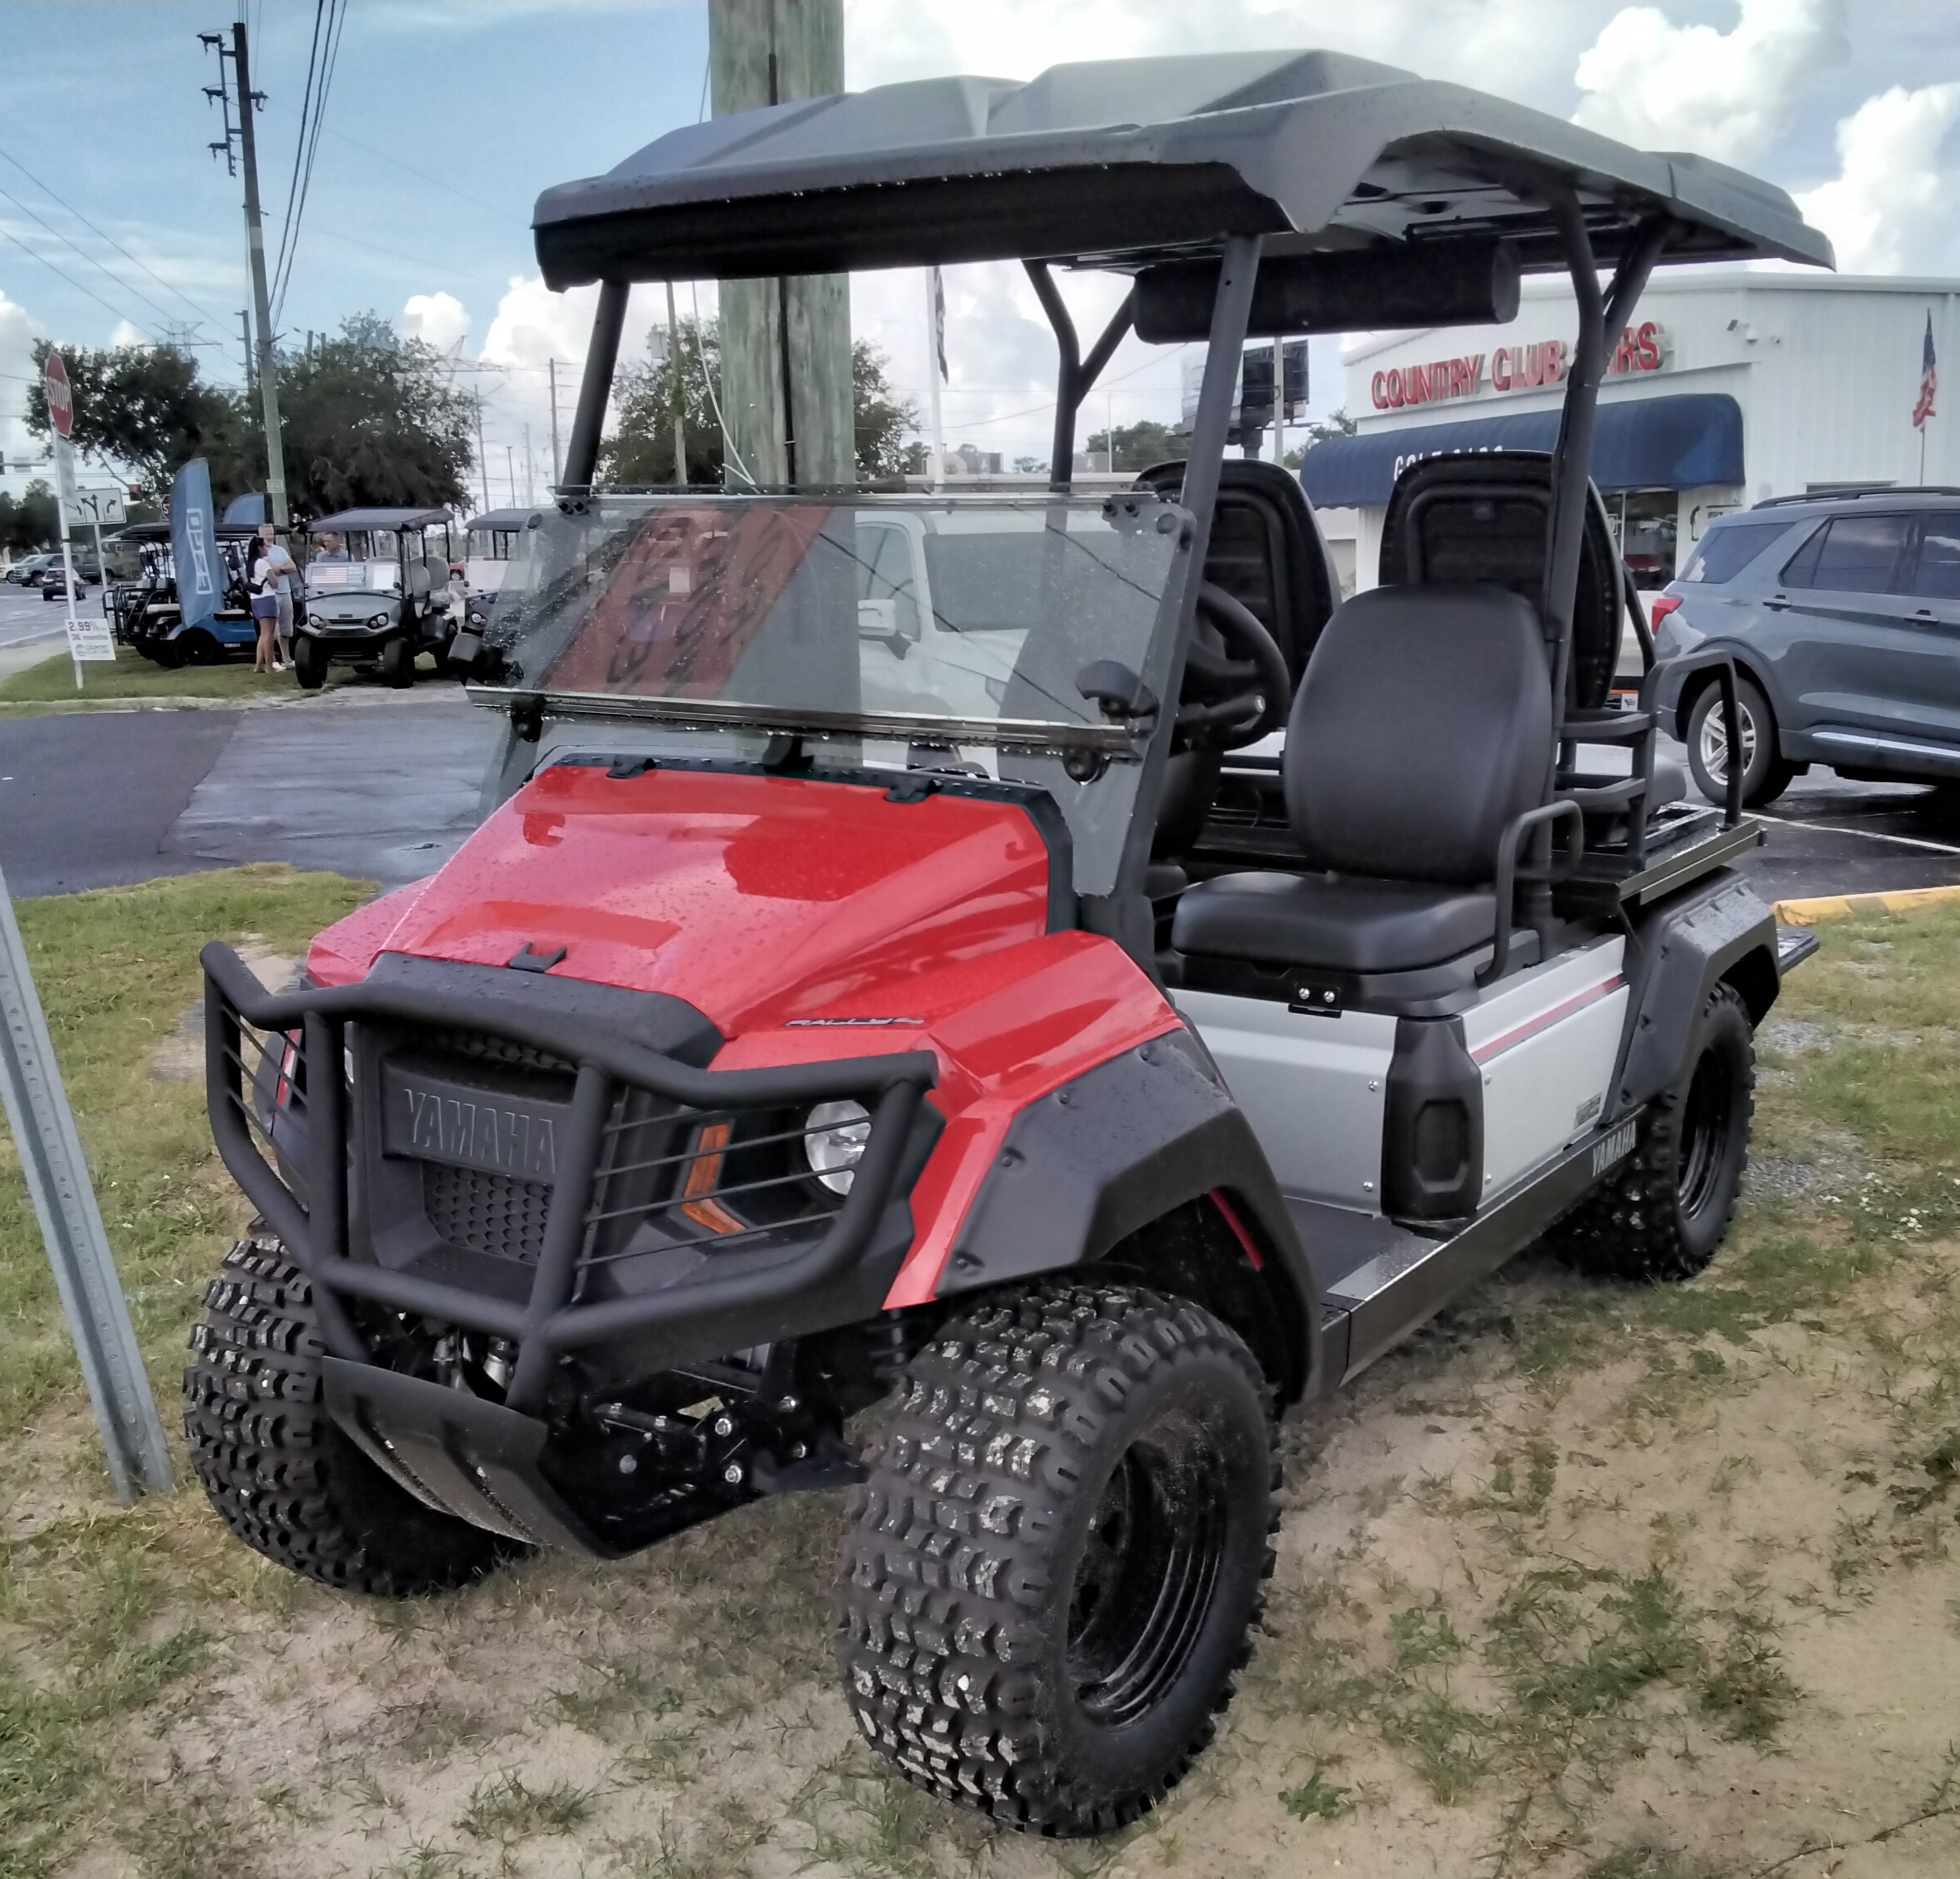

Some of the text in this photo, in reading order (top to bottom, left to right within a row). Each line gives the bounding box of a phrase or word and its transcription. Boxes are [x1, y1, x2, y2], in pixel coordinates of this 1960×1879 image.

[48, 376, 69, 412] STOP
[1371, 354, 1483, 409] COUNTRY
[1492, 339, 1565, 392] CLUB
[403, 1088, 557, 1175] YAMAHA
[1591, 1120, 1637, 1178] YAMAHA
